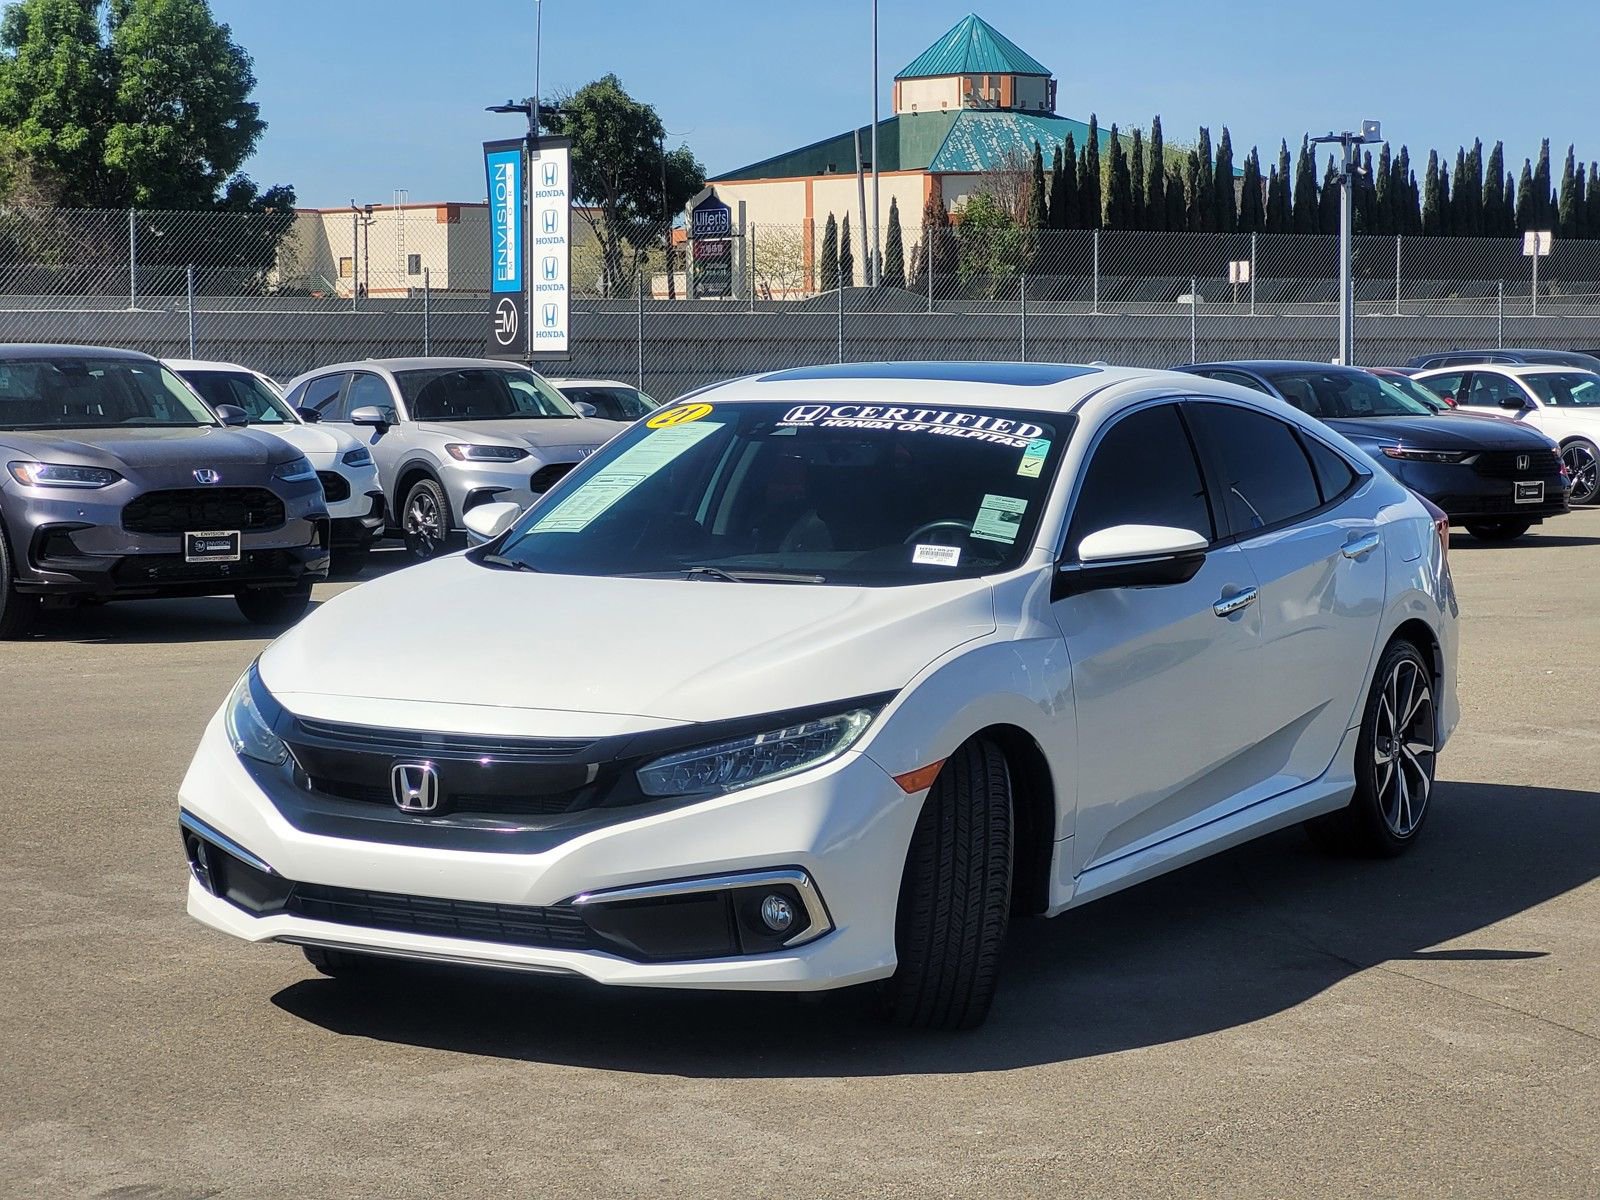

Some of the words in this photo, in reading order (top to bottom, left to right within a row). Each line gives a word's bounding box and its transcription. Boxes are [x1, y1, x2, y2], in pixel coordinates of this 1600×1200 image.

[535, 189, 565, 198] HONDA
[494, 164, 507, 281] ENVISION
[695, 211, 727, 226] Ulferts
[535, 236, 565, 245] HONDA
[535, 283, 565, 292] HONDA
[535, 330, 565, 339] HONDA
[654, 406, 704, 425] 21
[831, 405, 1043, 438] CERTIFIED
[820, 419, 893, 430] HONDA
[897, 422, 931, 433] OF
[928, 425, 1031, 448] MILPITAS
